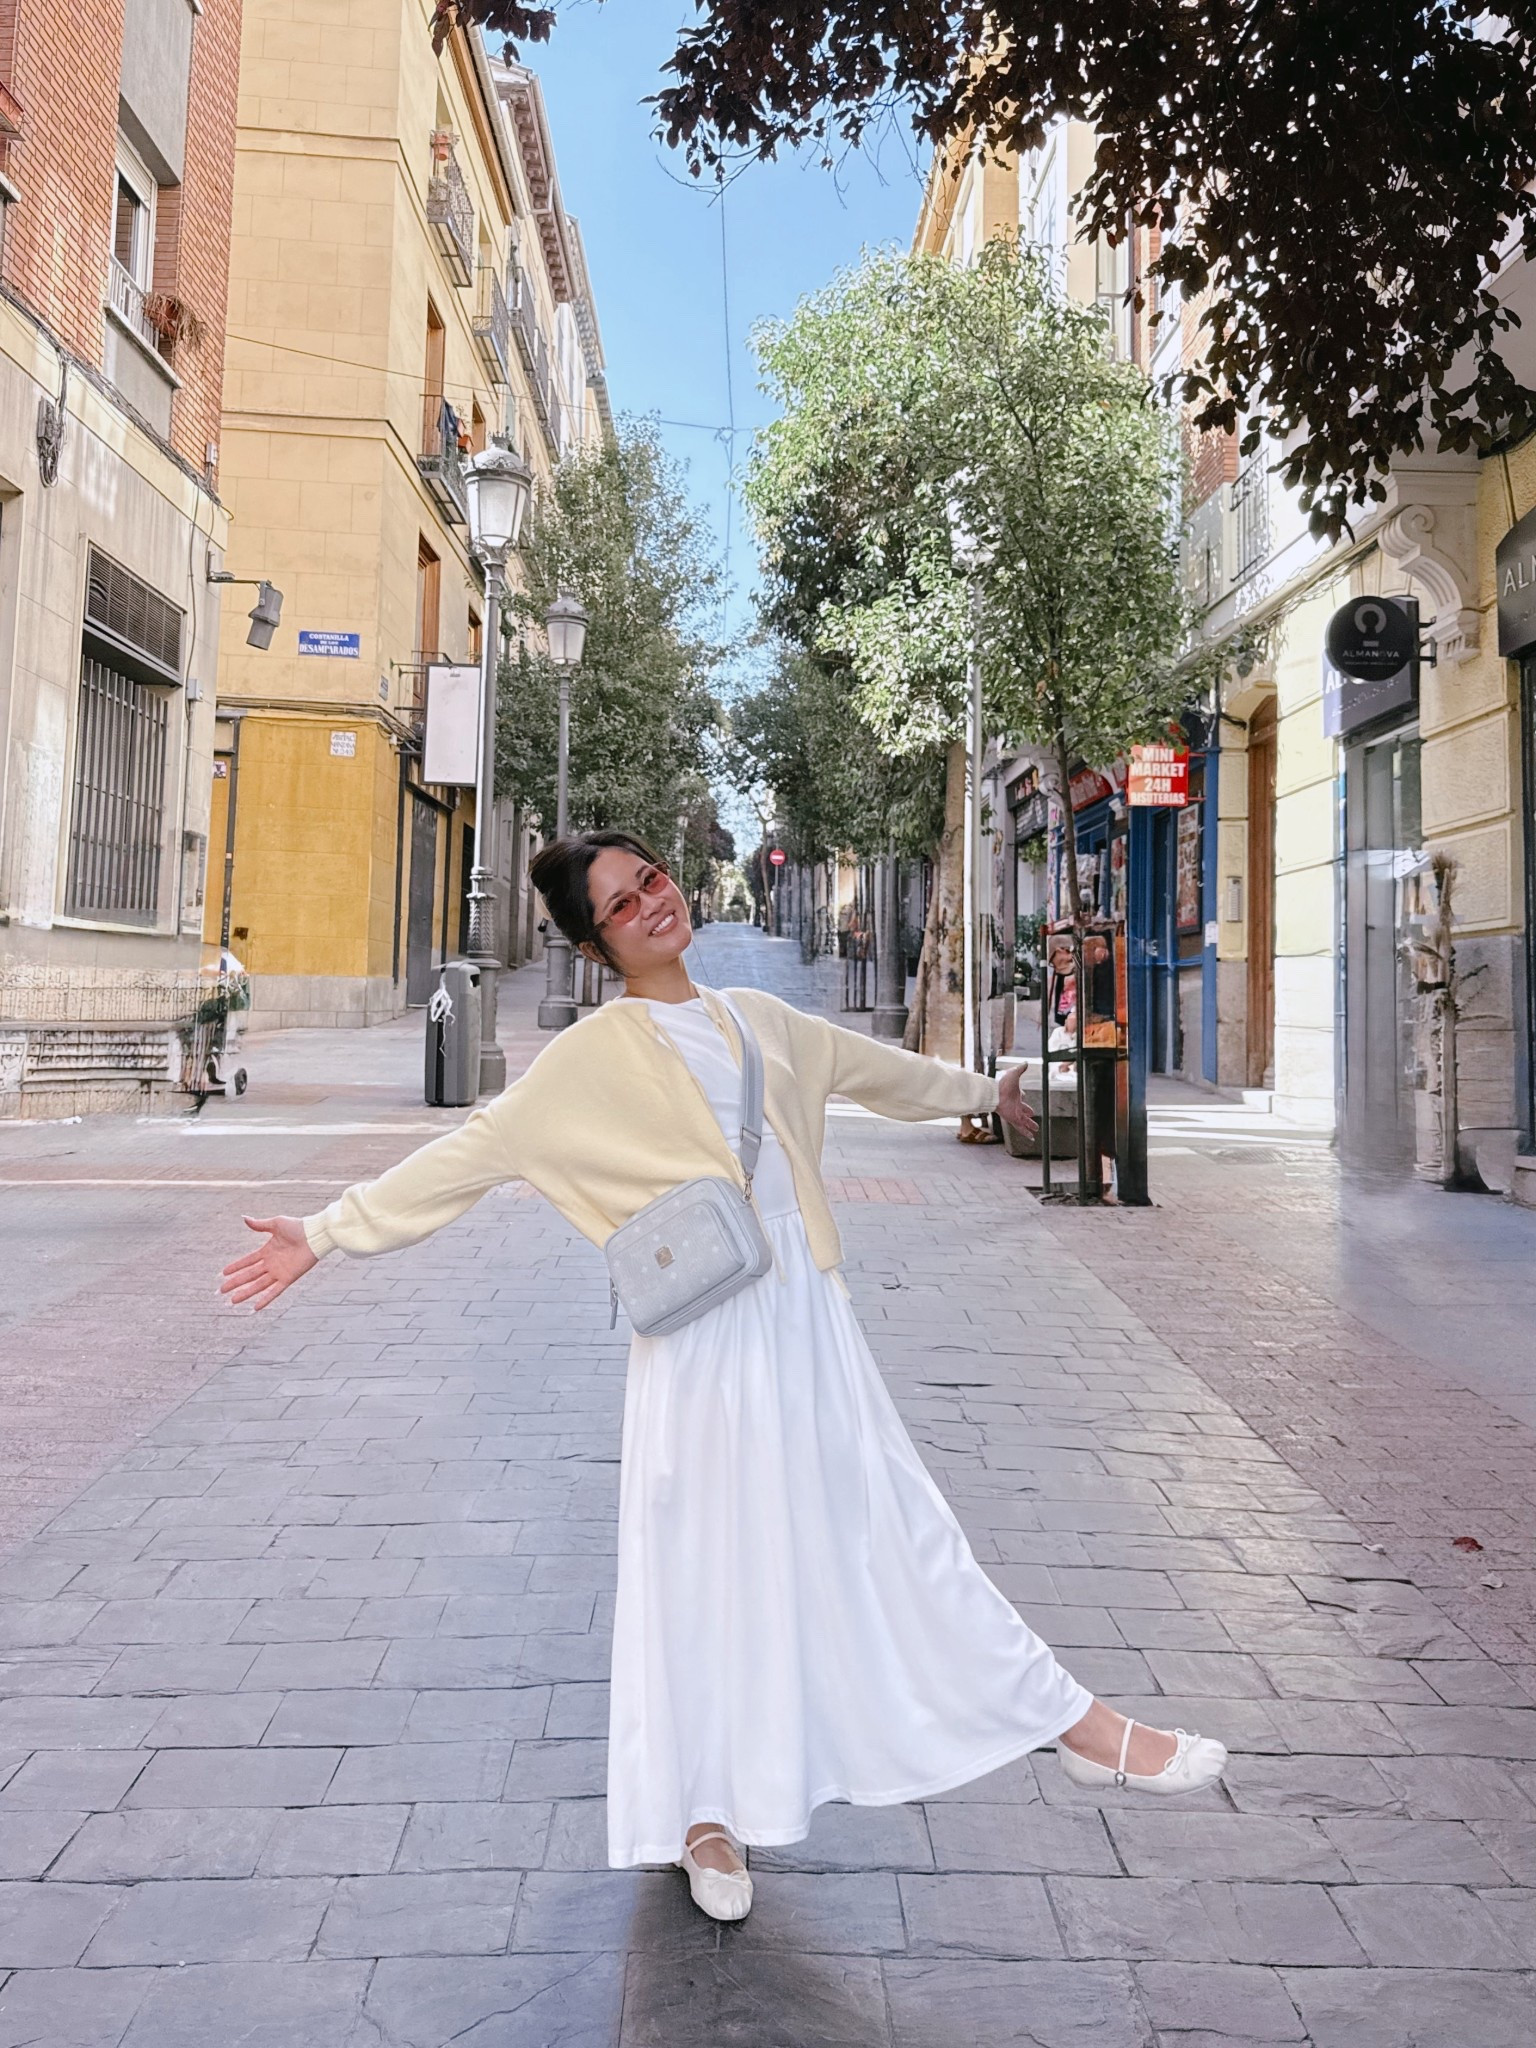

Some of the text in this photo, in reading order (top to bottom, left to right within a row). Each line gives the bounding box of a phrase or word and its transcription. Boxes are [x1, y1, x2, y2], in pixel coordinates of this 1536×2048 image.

[299, 643, 359, 656] DESAMPARADOS
[1342, 650, 1400, 658] ALMANOVA
[1142, 747, 1175, 762] MINI
[1131, 762, 1186, 777] MARKET
[1144, 778, 1172, 792] 24H
[1131, 792, 1186, 804] BISUTERIAS
